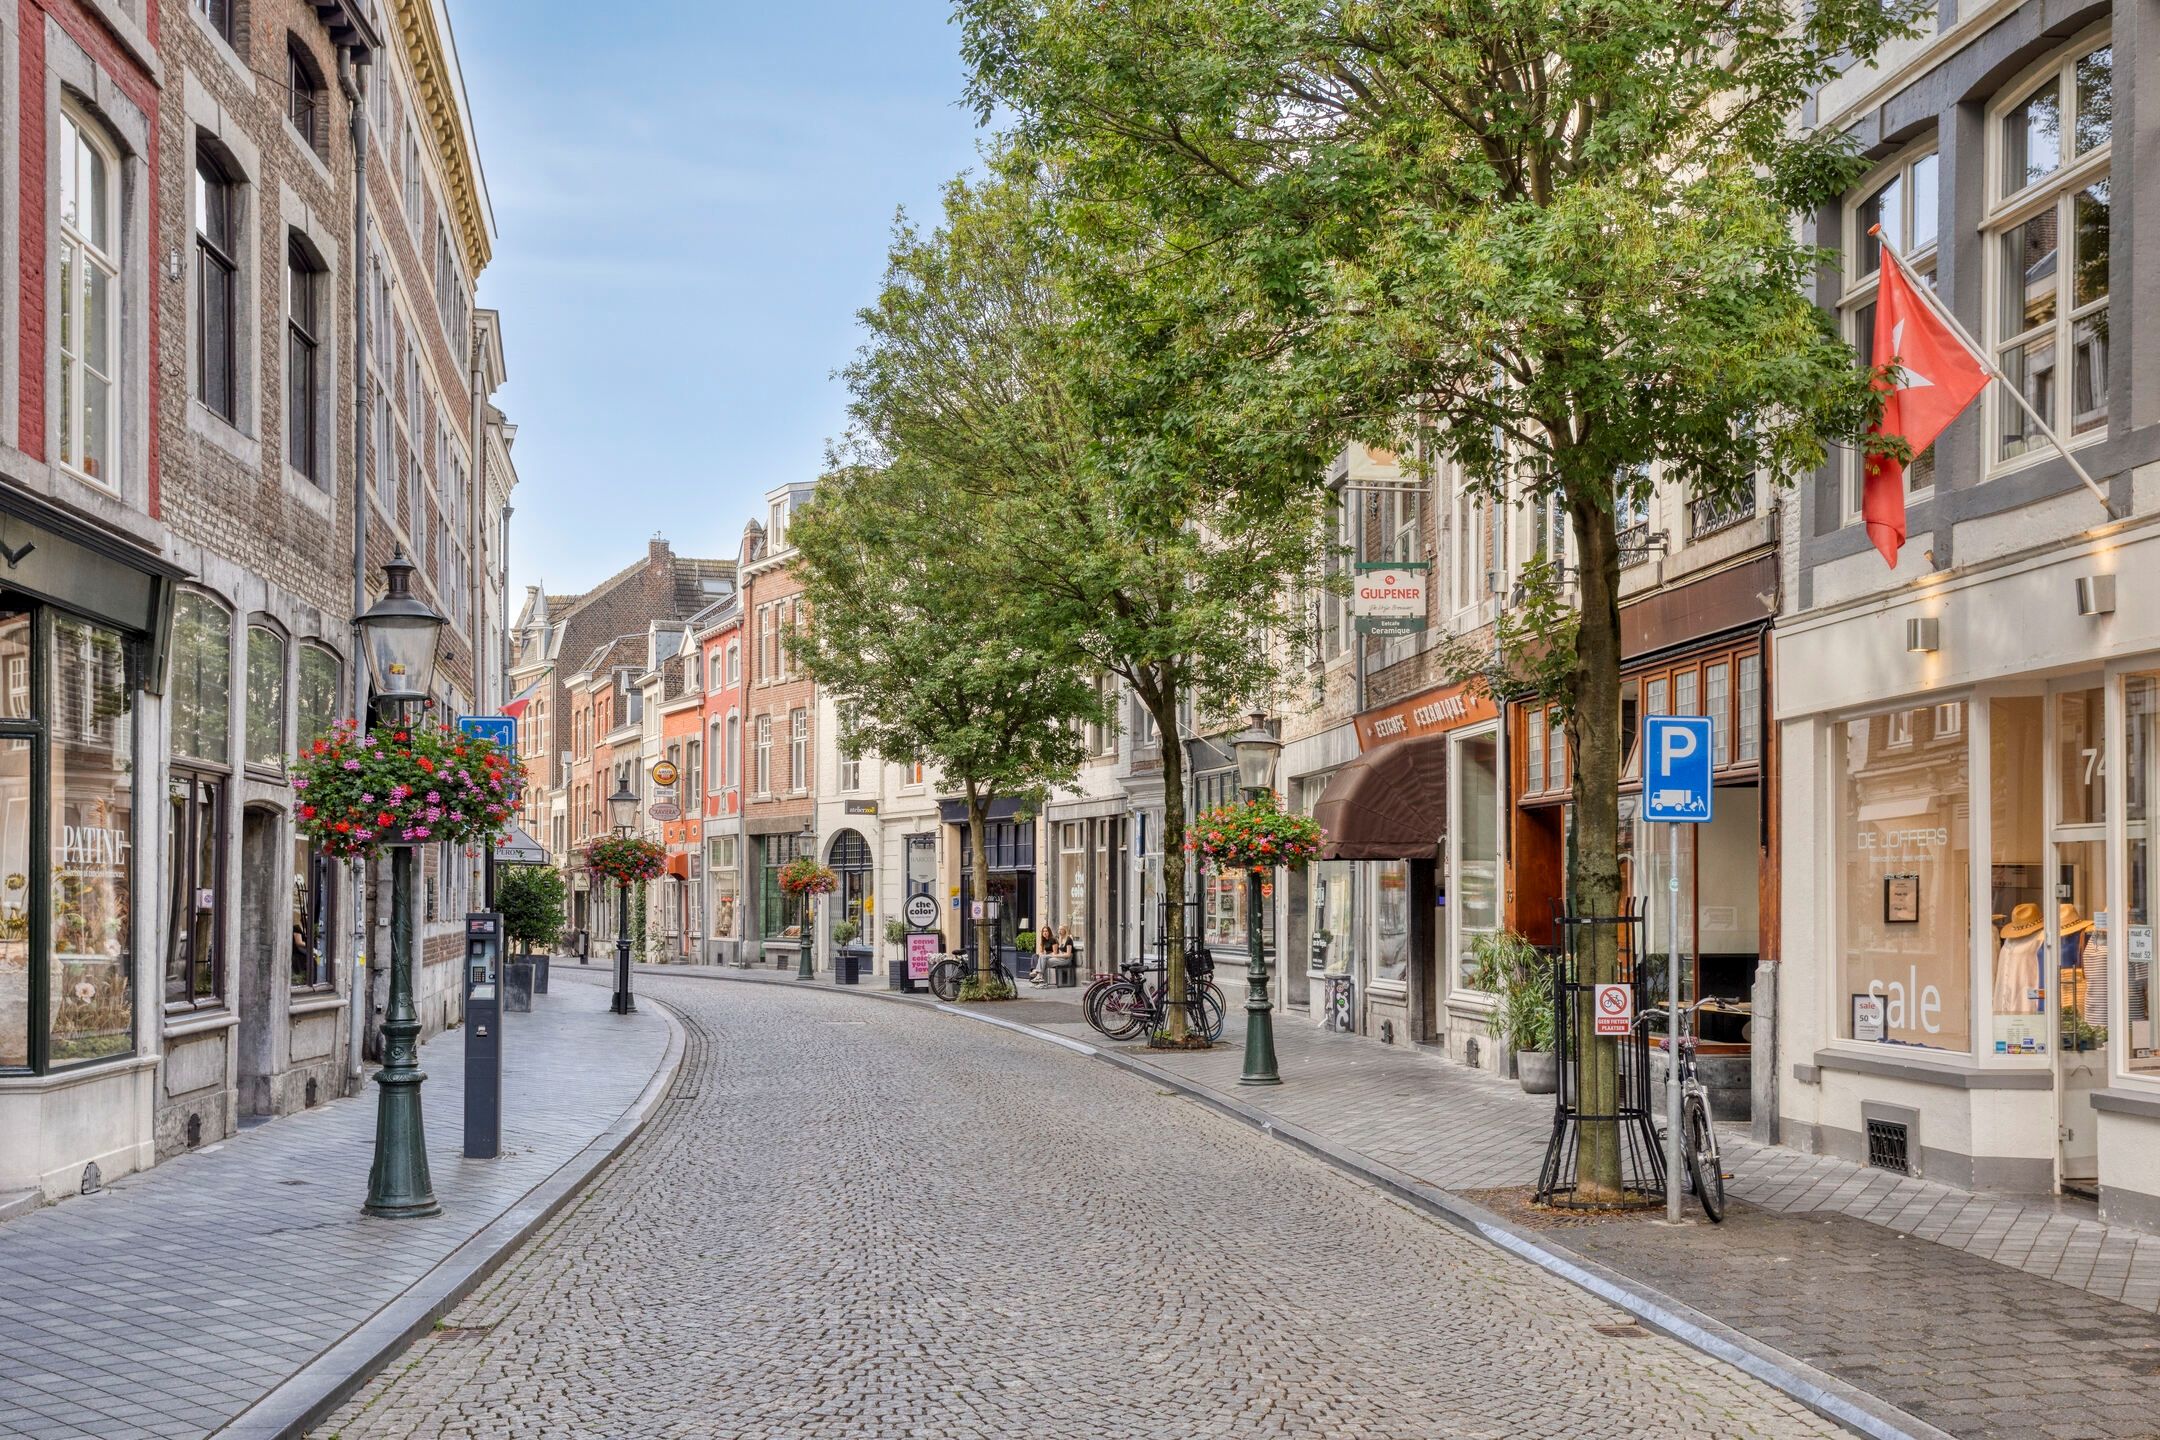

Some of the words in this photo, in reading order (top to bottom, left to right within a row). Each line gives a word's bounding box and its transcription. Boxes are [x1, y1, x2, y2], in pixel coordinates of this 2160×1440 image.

[1360, 587, 1420, 599] GULPENER
[1371, 627, 1411, 635] Ceramique
[1413, 695, 1467, 727] CERAMIQUE
[1661, 726, 1697, 776] P
[64, 825, 124, 864] PATINE
[1857, 832, 1877, 849] DE
[1881, 828, 1947, 848] JOFFERS
[1868, 965, 1941, 1034] sale
